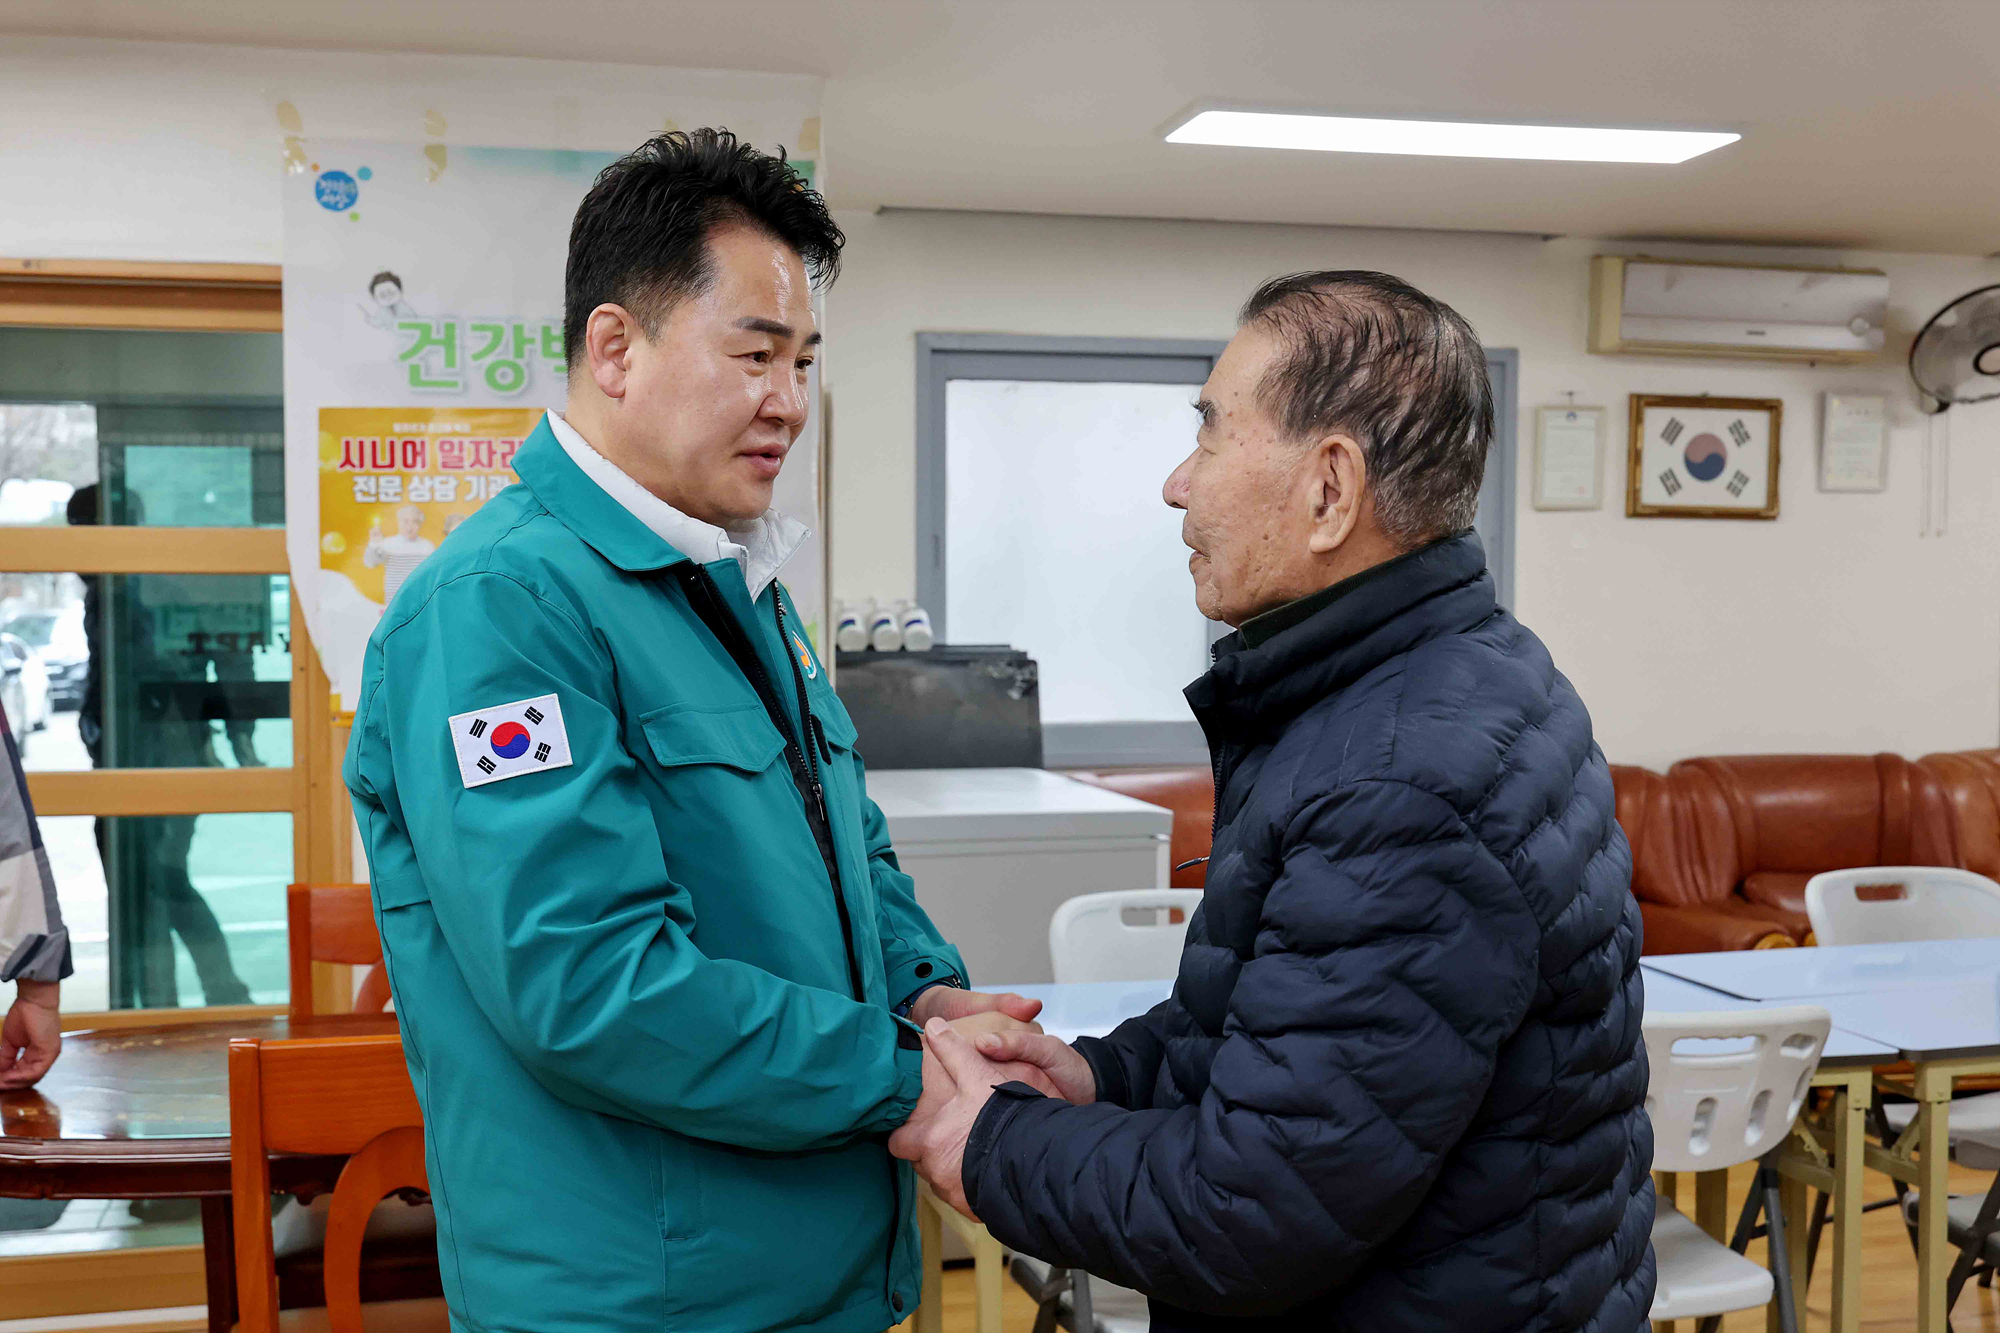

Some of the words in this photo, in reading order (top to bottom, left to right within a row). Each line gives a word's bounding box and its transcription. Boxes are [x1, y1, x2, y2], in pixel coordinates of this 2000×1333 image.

[338, 439, 426, 469] 시니어
[352, 475, 402, 503] 전문
[408, 475, 459, 503] 상담
